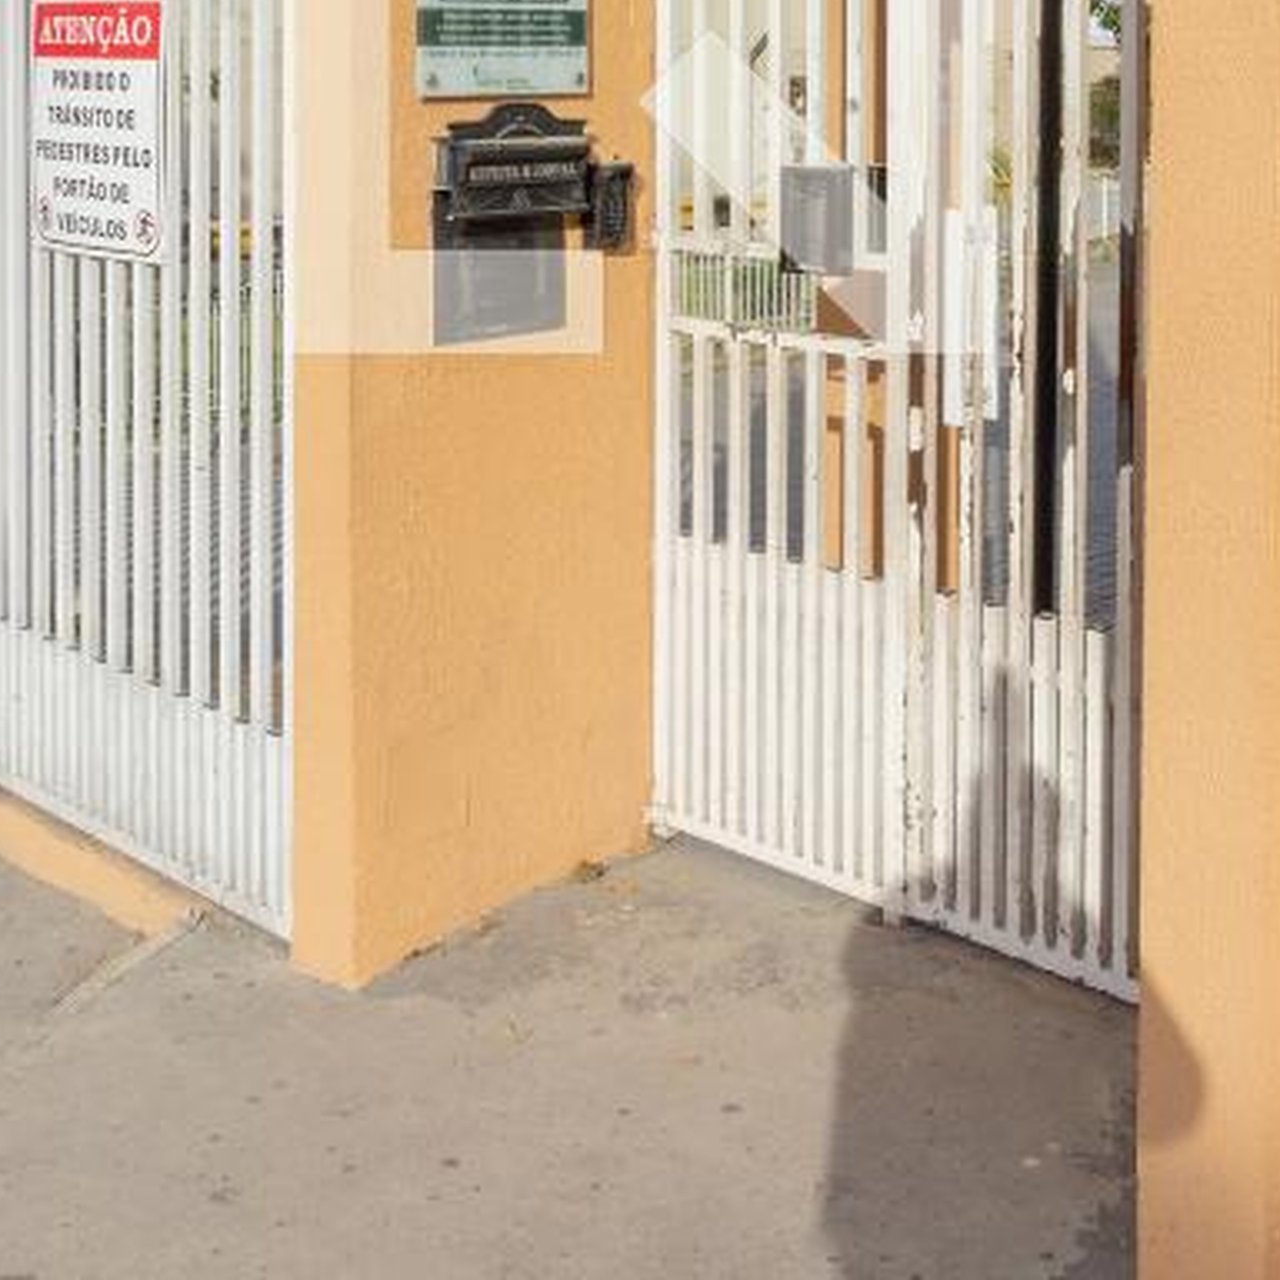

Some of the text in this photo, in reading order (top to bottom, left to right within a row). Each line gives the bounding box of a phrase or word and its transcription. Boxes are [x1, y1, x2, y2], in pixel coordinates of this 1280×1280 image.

[39, 7, 153, 54] ATENÇÃO
[53, 69, 116, 91] PROIBIDO
[117, 108, 135, 131] DE
[36, 139, 153, 168] PEDESTRES PELO
[110, 181, 130, 204] DE
